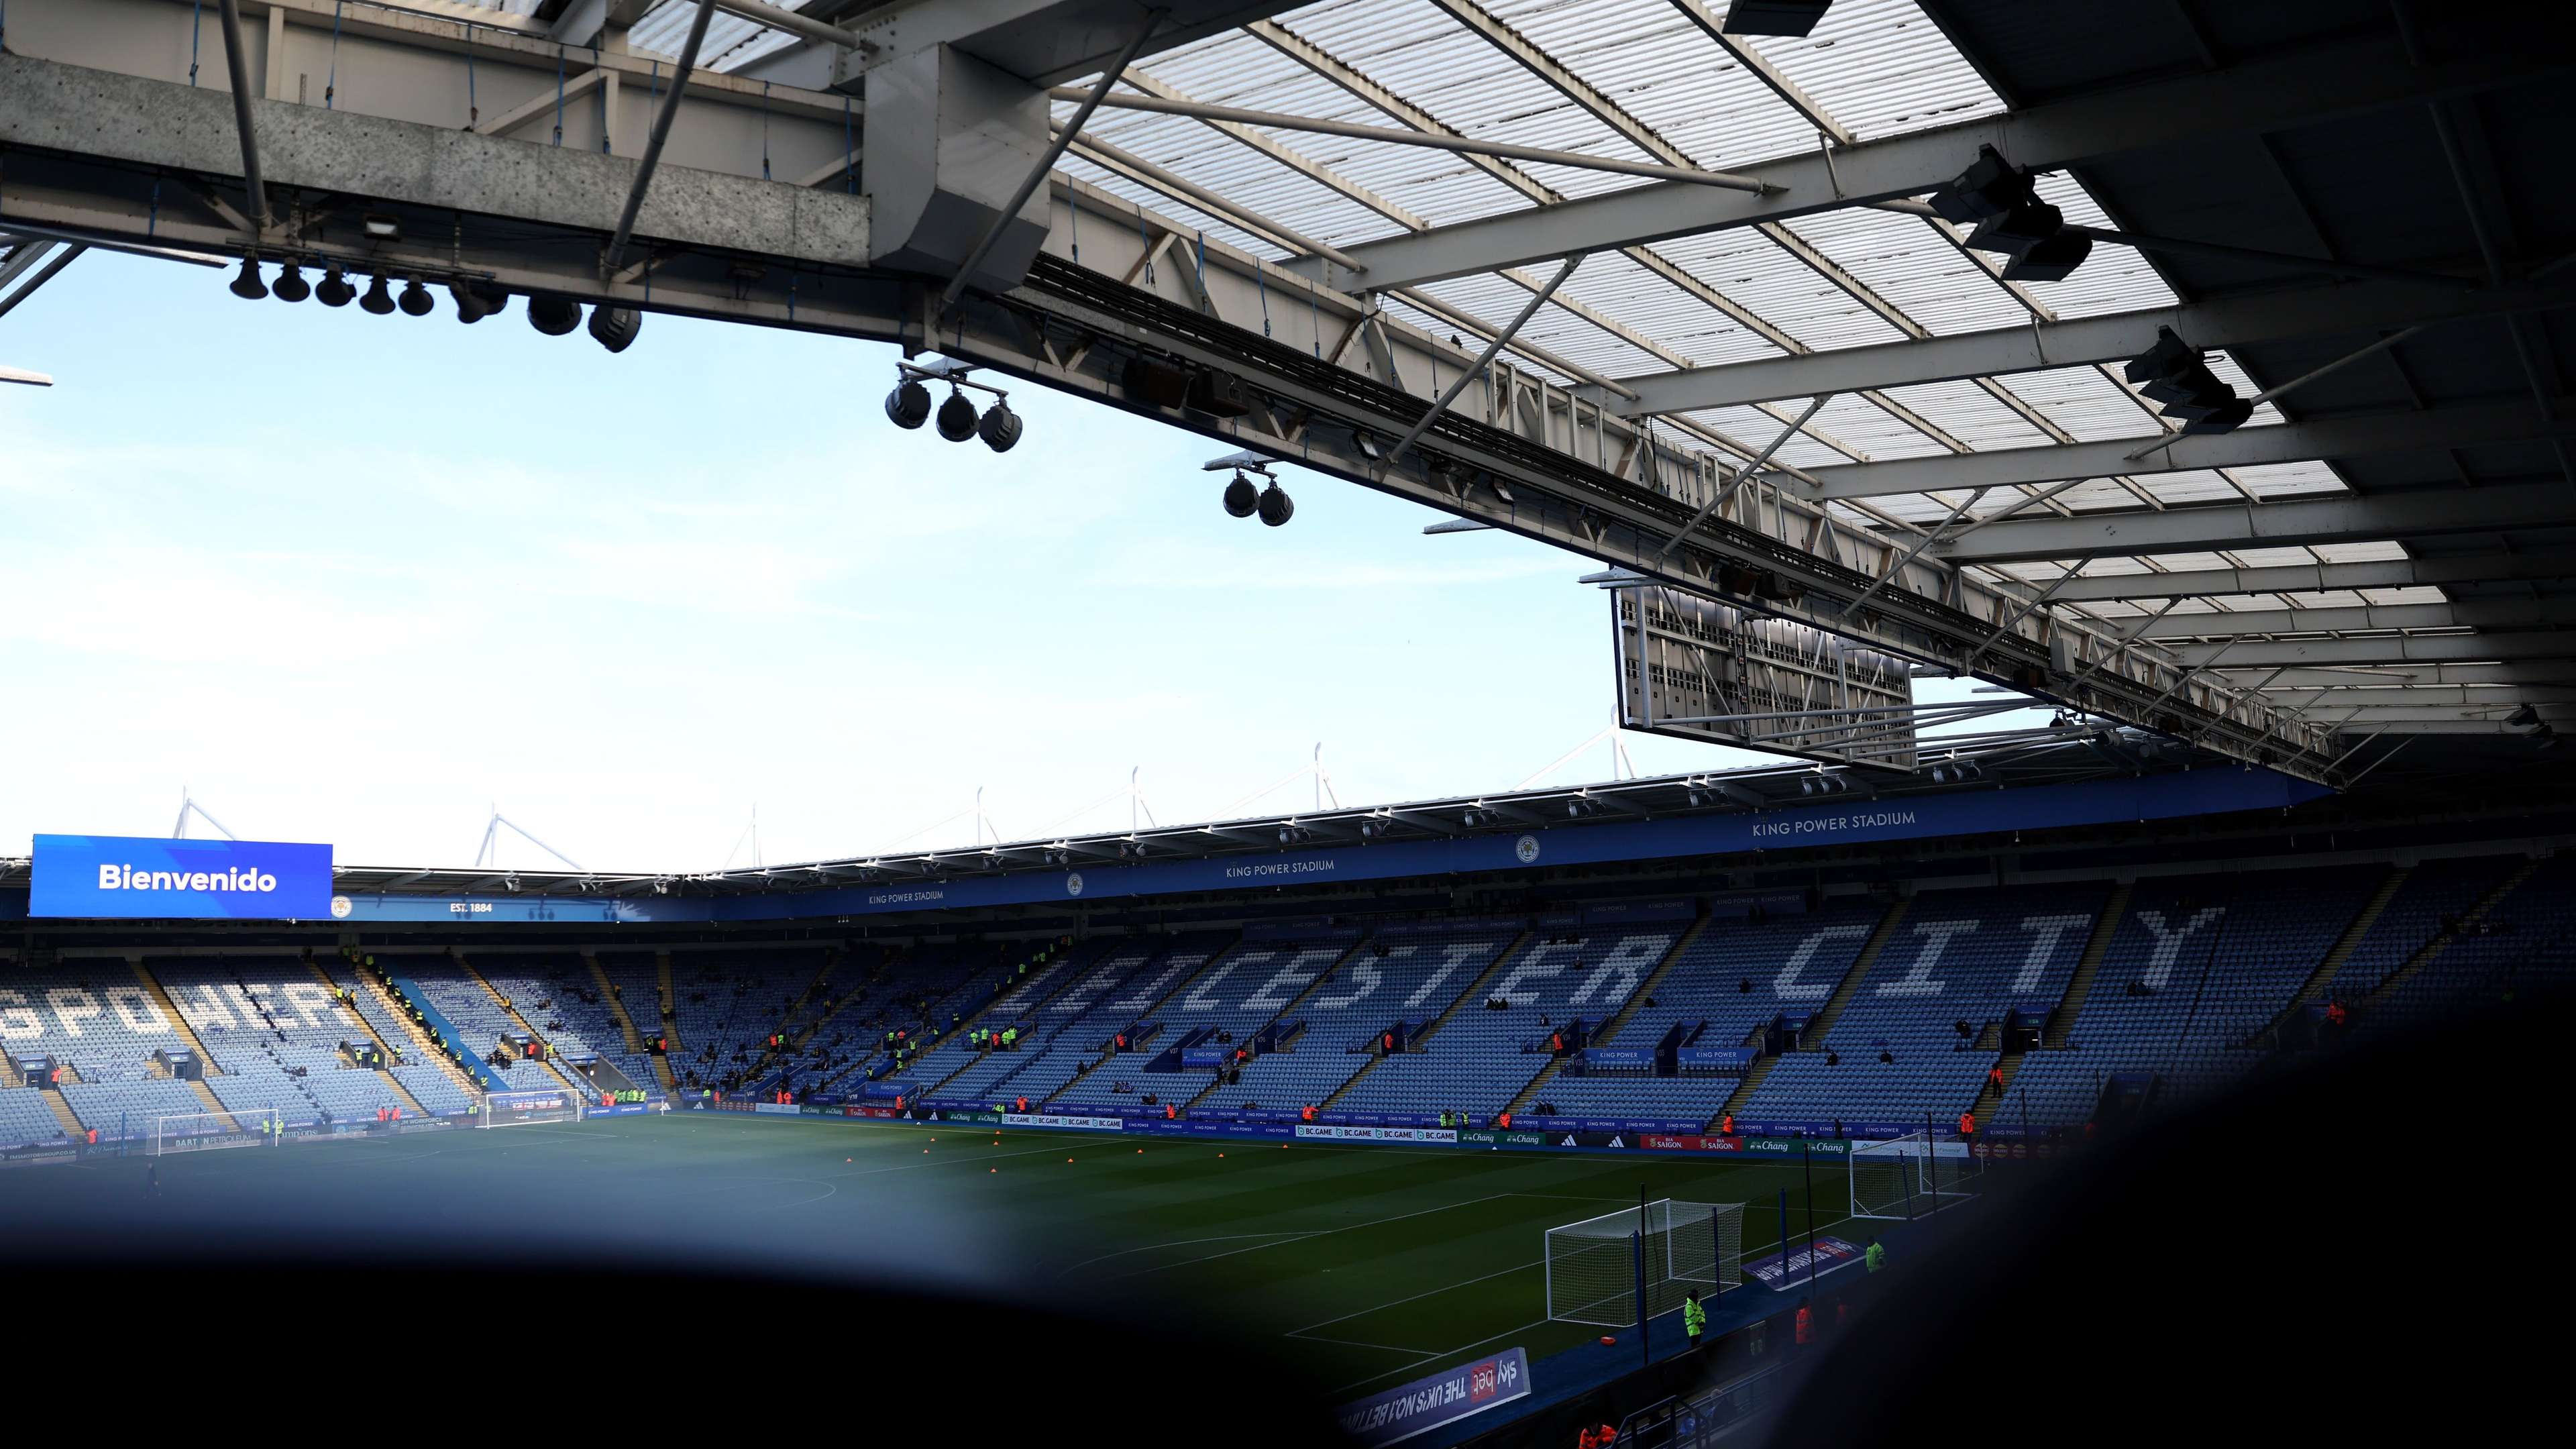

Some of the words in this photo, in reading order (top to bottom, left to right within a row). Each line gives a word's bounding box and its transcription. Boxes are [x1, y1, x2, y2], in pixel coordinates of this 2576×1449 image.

[1753, 822, 1790, 836] KING
[1794, 817, 1847, 833] POWER
[1852, 812, 1915, 828] STADIUM
[1226, 867, 1252, 878] KING
[1254, 863, 1289, 875] POWER
[1292, 860, 1334, 873] STADIUM
[99, 863, 277, 892] Bienvenido
[869, 895, 887, 904] KING
[888, 893, 913, 903] POWER
[914, 890, 944, 901] STADIUM
[450, 903, 468, 912] EST.
[470, 903, 492, 912] 1884
[1607, 905, 1627, 913] POWER
[992, 934, 1672, 1014] LEICESTER
[1773, 907, 2226, 1000] CITY
[983, 1114, 999, 1123] Chang
[1068, 1118, 1090, 1126] BC.GAME
[1099, 1120, 1122, 1128] BC.GAME
[1305, 1128, 1333, 1136] BC.GAME
[1344, 1129, 1372, 1137] BC.GAME
[1384, 1130, 1413, 1138] BC.GAME
[1426, 1132, 1455, 1140] BC.GAME
[1472, 1133, 1495, 1143] Chang
[1516, 1134, 1540, 1144] Chang
[1762, 1140, 1789, 1152] Chang
[1817, 1142, 1844, 1153] Chang
[1497, 1360, 1517, 1388] sky
[1473, 1368, 1495, 1395] bet
[1444, 1377, 1466, 1404] THE
[1417, 1385, 1443, 1413] UK'S
